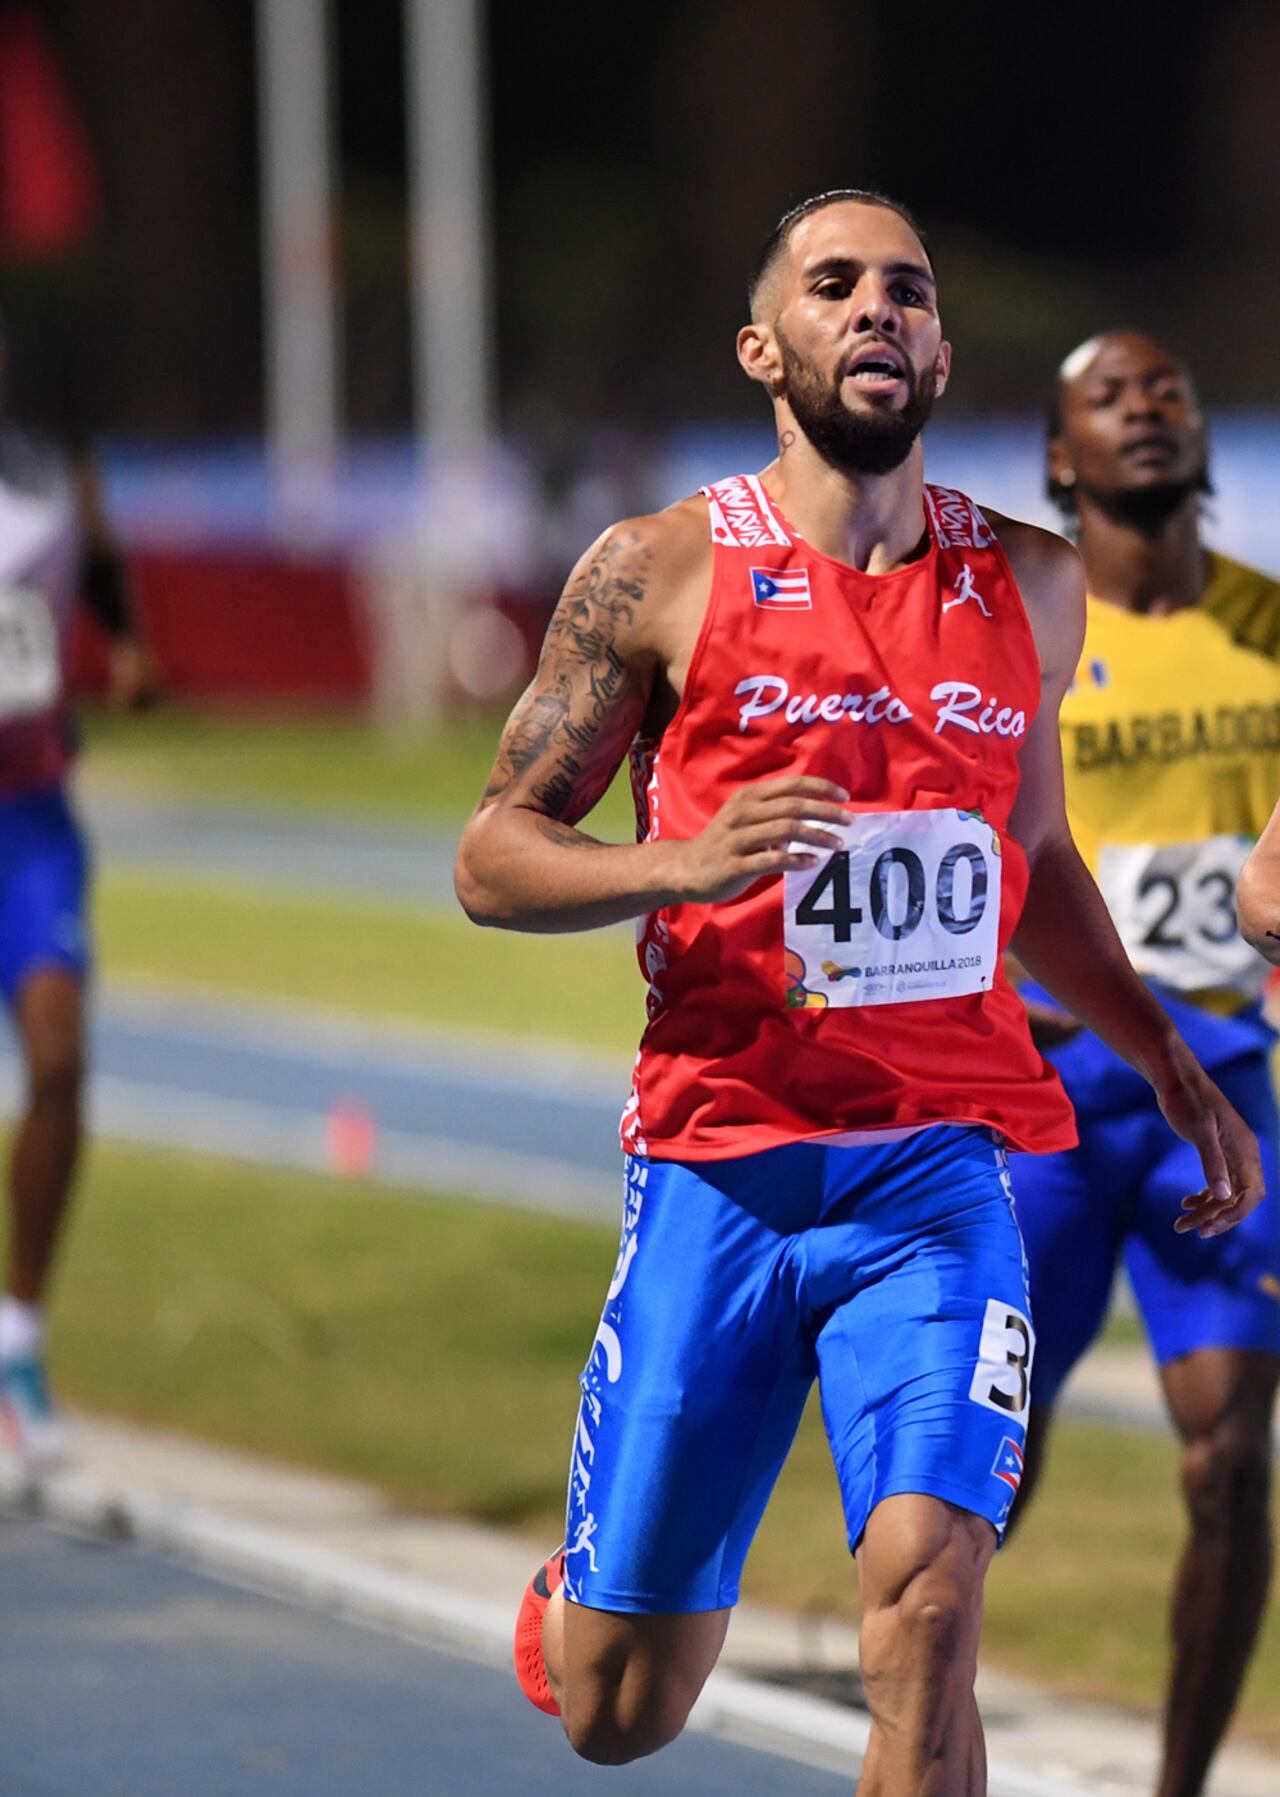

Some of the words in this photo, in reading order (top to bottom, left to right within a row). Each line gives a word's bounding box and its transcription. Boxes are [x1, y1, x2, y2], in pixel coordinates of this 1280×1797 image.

[734, 674, 912, 734] Puerto
[929, 681, 1026, 739] Rico
[794, 842, 988, 943] 400
[865, 959, 957, 978] BARRANQUILLA
[958, 955, 982, 969] 2018
[988, 1314, 1030, 1413] 3
